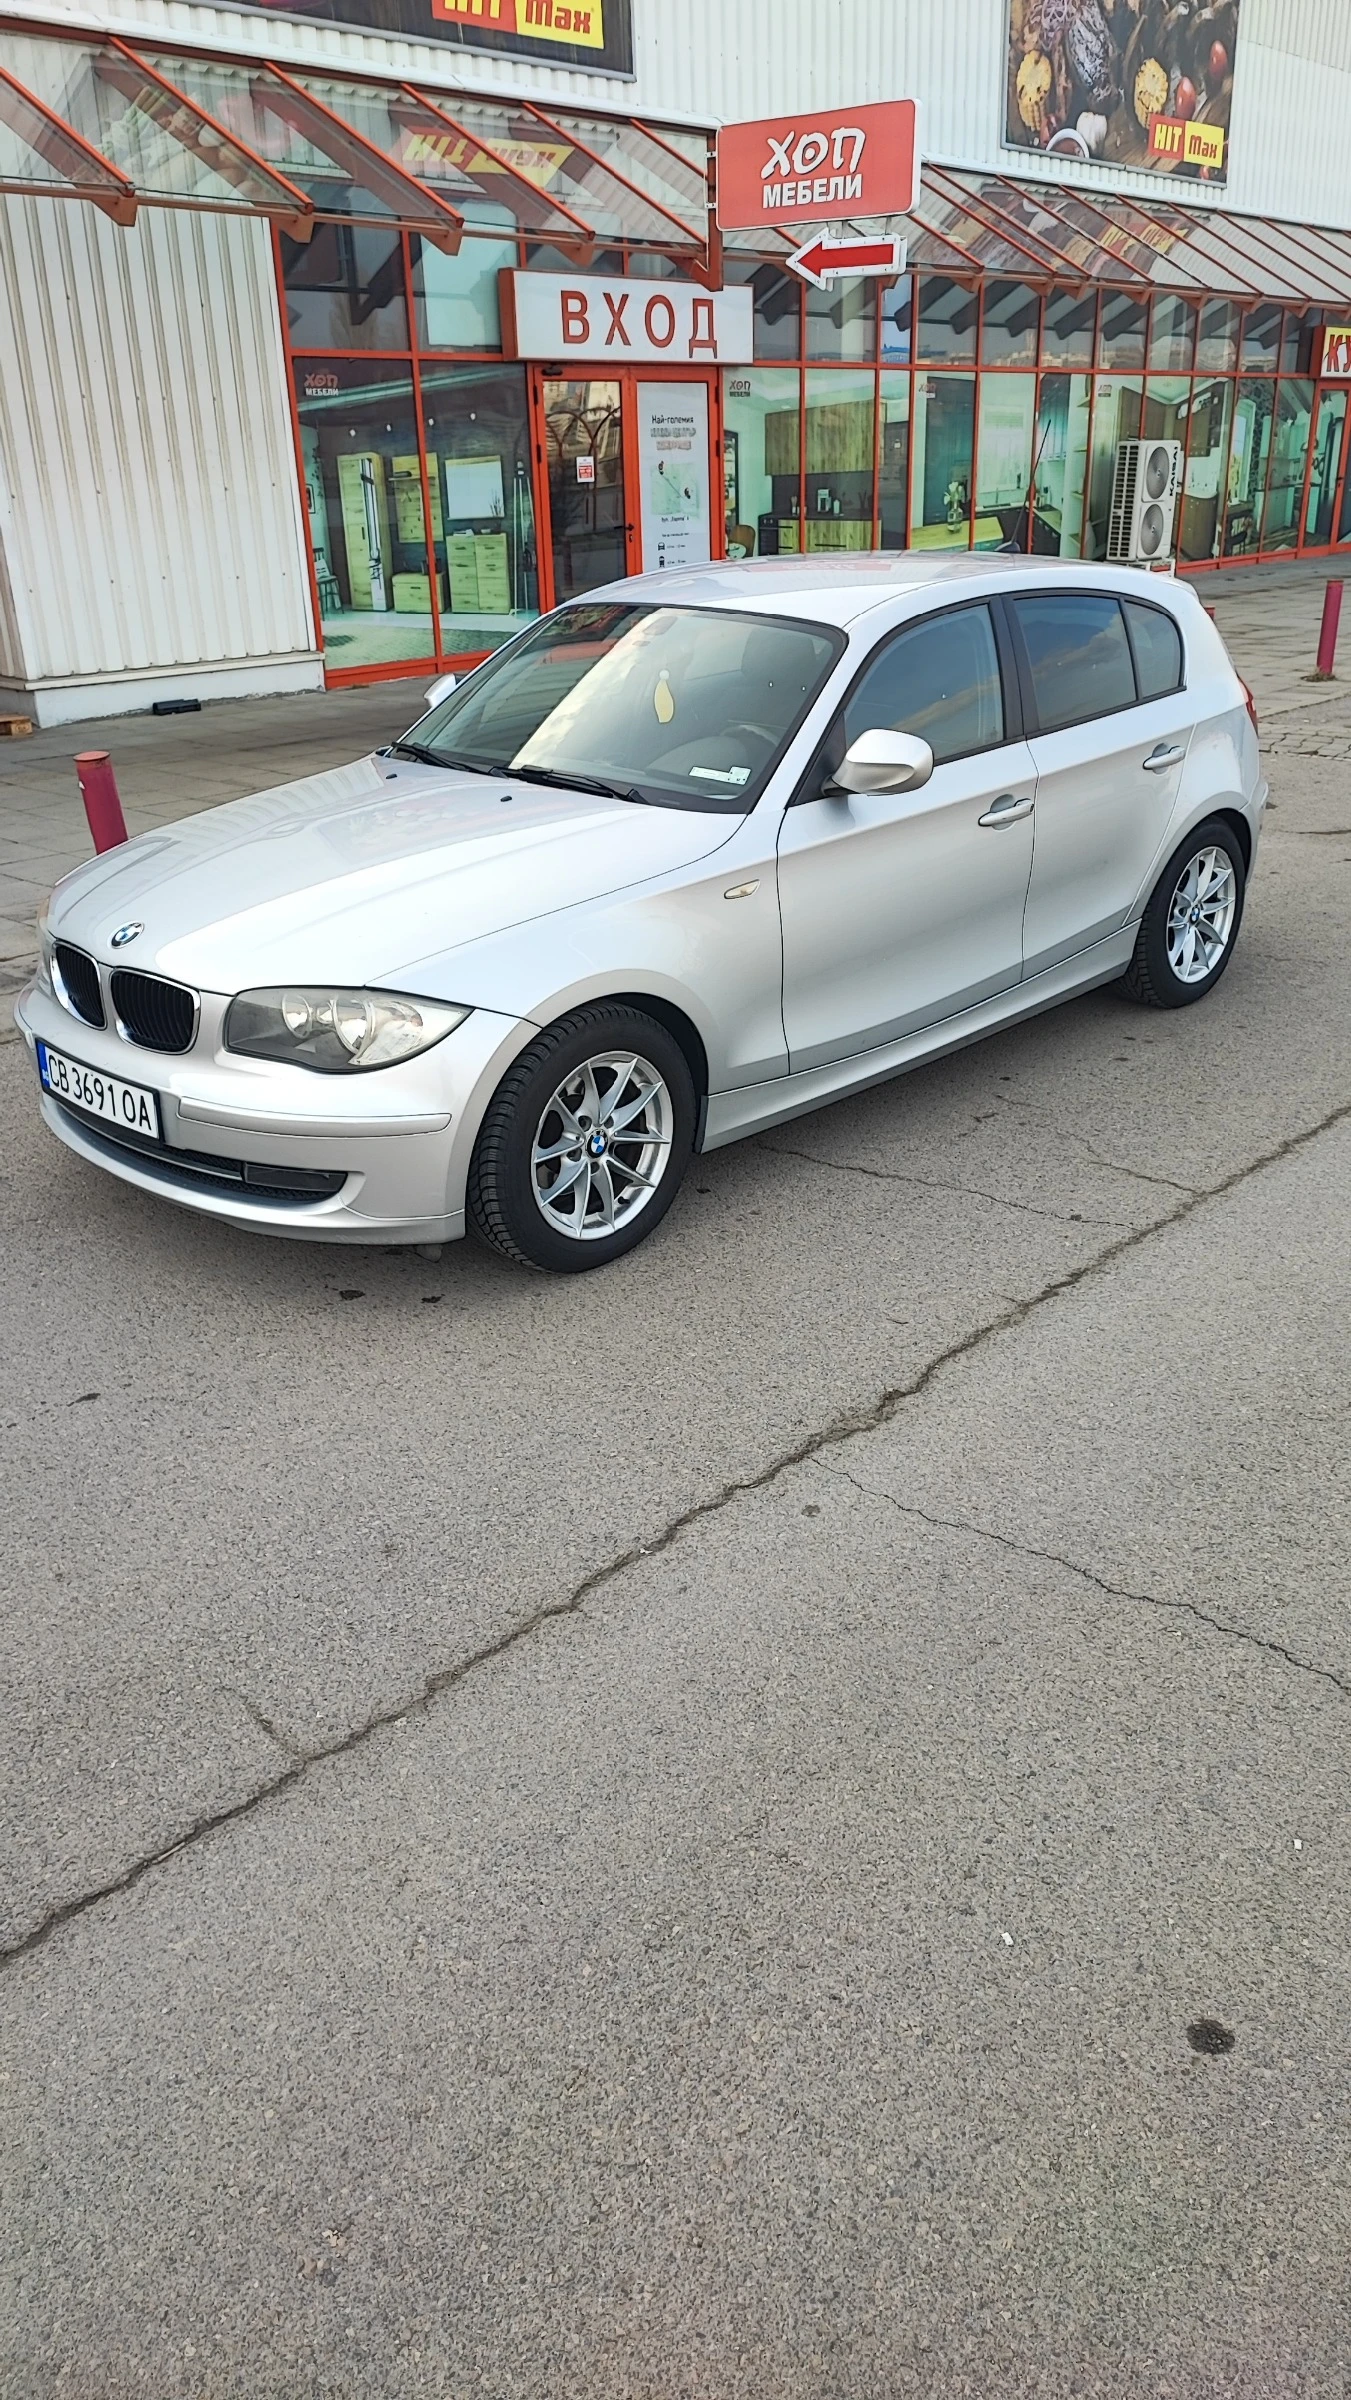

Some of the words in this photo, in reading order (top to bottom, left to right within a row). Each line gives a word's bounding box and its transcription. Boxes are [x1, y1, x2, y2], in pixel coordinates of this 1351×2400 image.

[760, 127, 866, 180] ХОП
[1153, 123, 1183, 153] HIT
[762, 173, 863, 209] МЕБЕЛИ
[560, 290, 718, 360] ВХОД
[304, 373, 339, 388] ХОП
[1169, 446, 1178, 497] KAISAI
[71, 1066, 116, 1117] 3691
